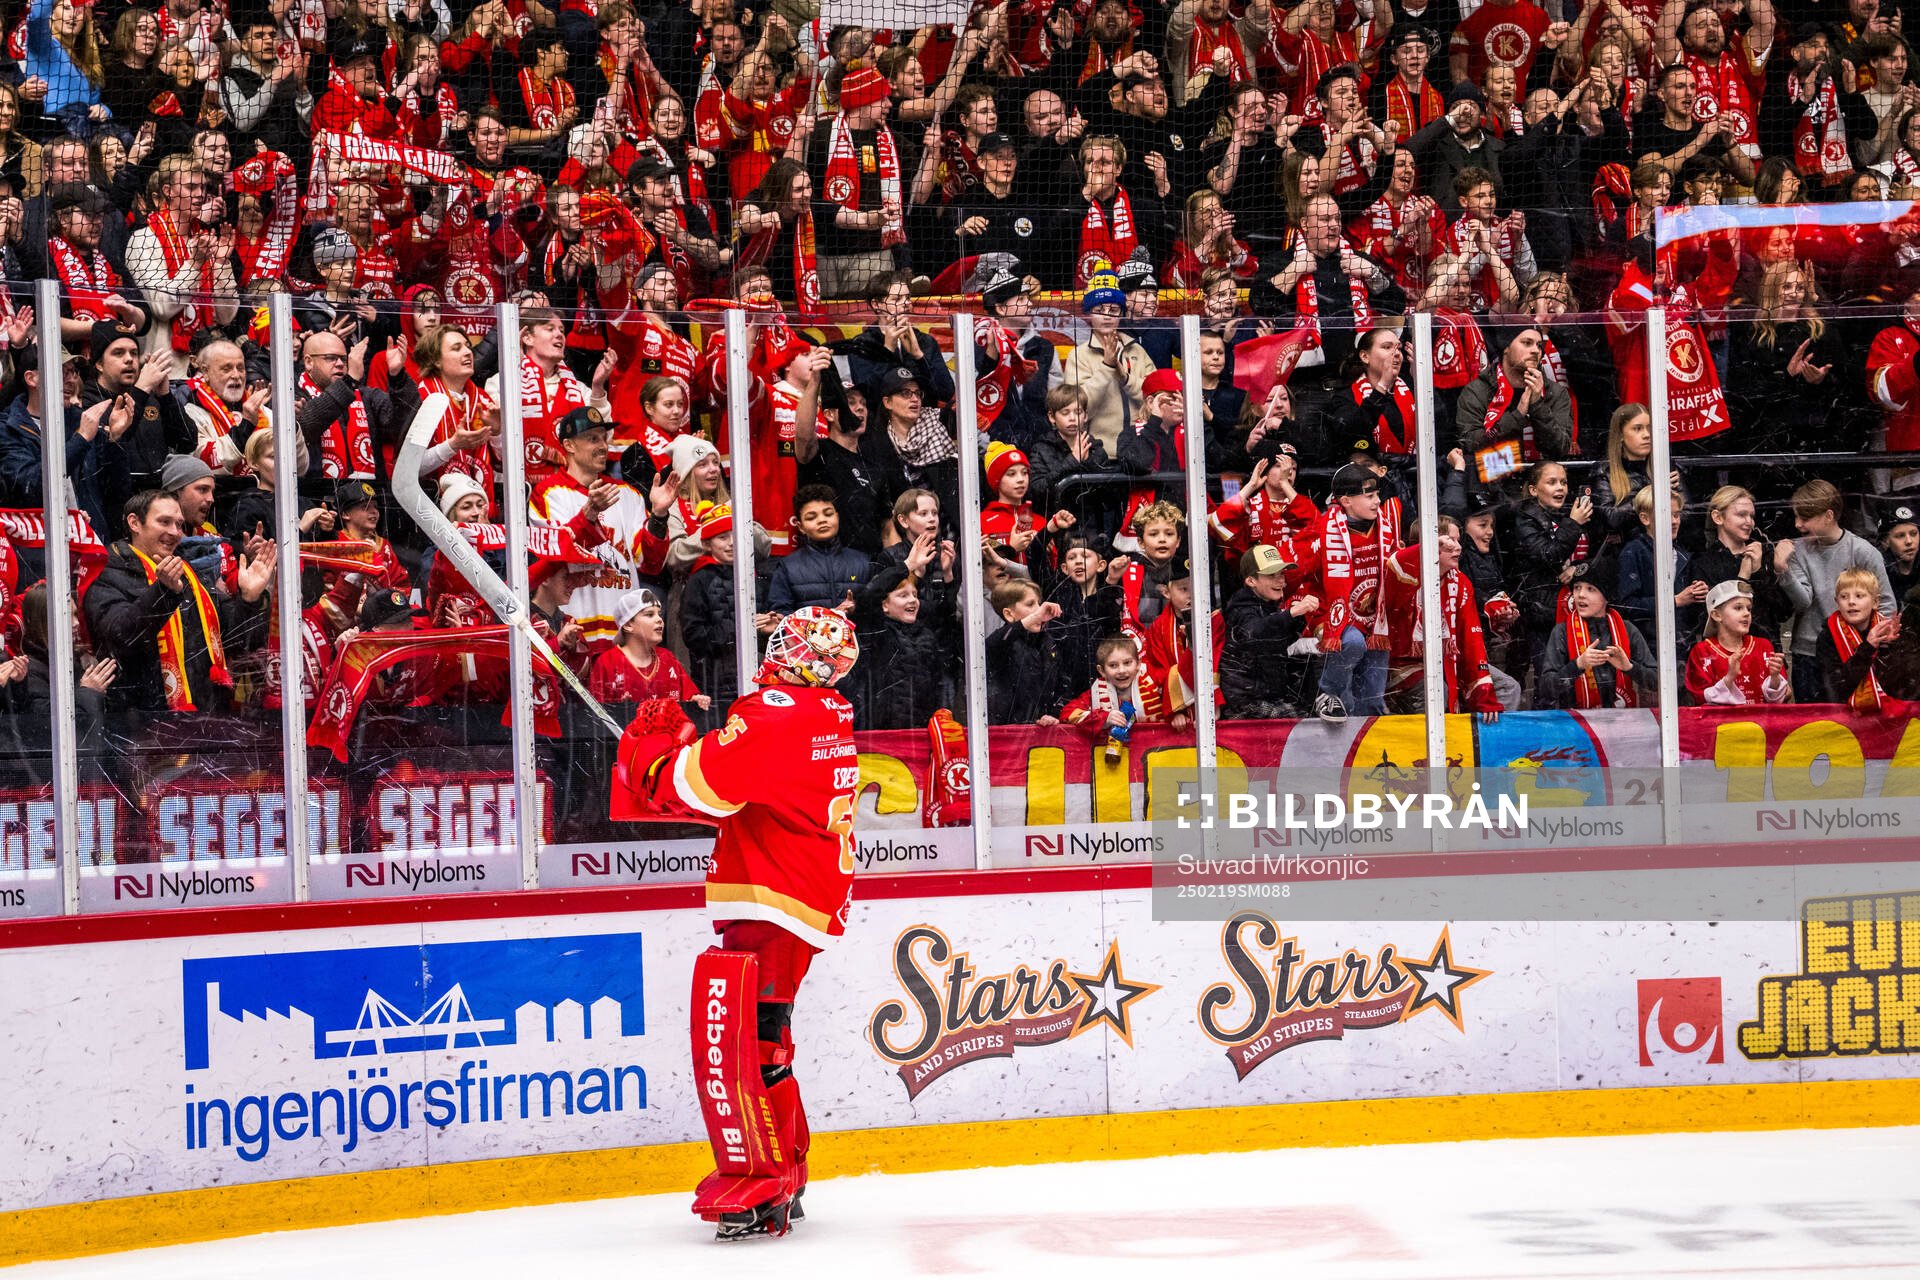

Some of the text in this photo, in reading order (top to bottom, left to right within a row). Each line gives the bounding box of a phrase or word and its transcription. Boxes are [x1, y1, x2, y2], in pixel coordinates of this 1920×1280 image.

[811, 733, 839, 743] KALMAR
[1299, 823, 1394, 852] Nybloms
[1528, 815, 1624, 844] Nybloms
[1803, 807, 1901, 836] Nybloms
[1070, 832, 1164, 862] Nybloms
[391, 859, 485, 892] Nybloms
[616, 849, 709, 881] Nybloms
[160, 871, 254, 904] Nybloms
[1199, 911, 1410, 1044] Stars
[870, 926, 1081, 1063] Stars
[1344, 1001, 1403, 1019] STEAKHOUSE
[1015, 1017, 1073, 1037] STEAKHOUSE
[1242, 1017, 1334, 1064] AND STRIPES
[706, 978, 747, 1163] Råbergs Bil
[913, 1034, 1005, 1083] AND STRIPES
[185, 1060, 648, 1162] ingenjörsfirman
